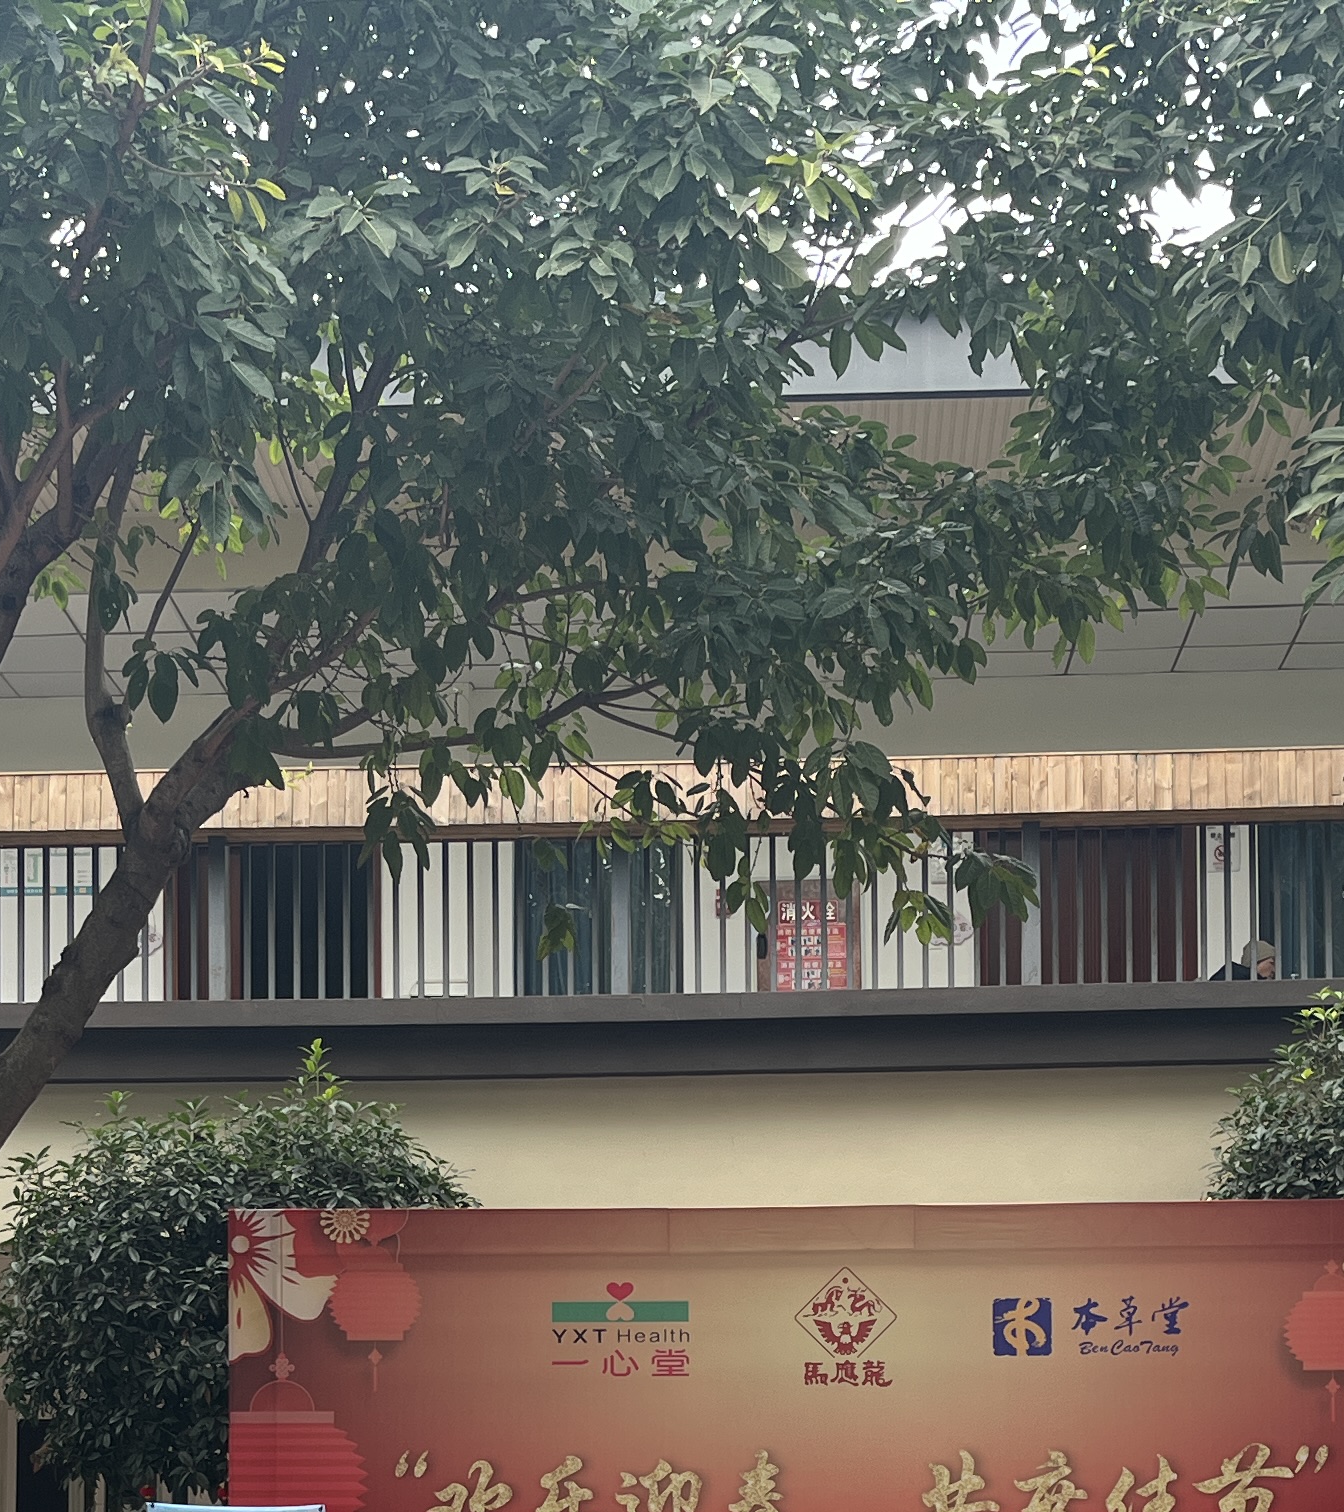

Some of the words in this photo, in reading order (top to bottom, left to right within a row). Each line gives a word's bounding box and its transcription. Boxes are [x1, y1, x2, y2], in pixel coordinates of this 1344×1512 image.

[1071, 1295, 1190, 1336] 本草堂
[552, 1328, 607, 1344] YXT
[616, 1328, 691, 1344] Health
[551, 1348, 690, 1378] 一心堂
[803, 1359, 894, 1388] 馬應龍
